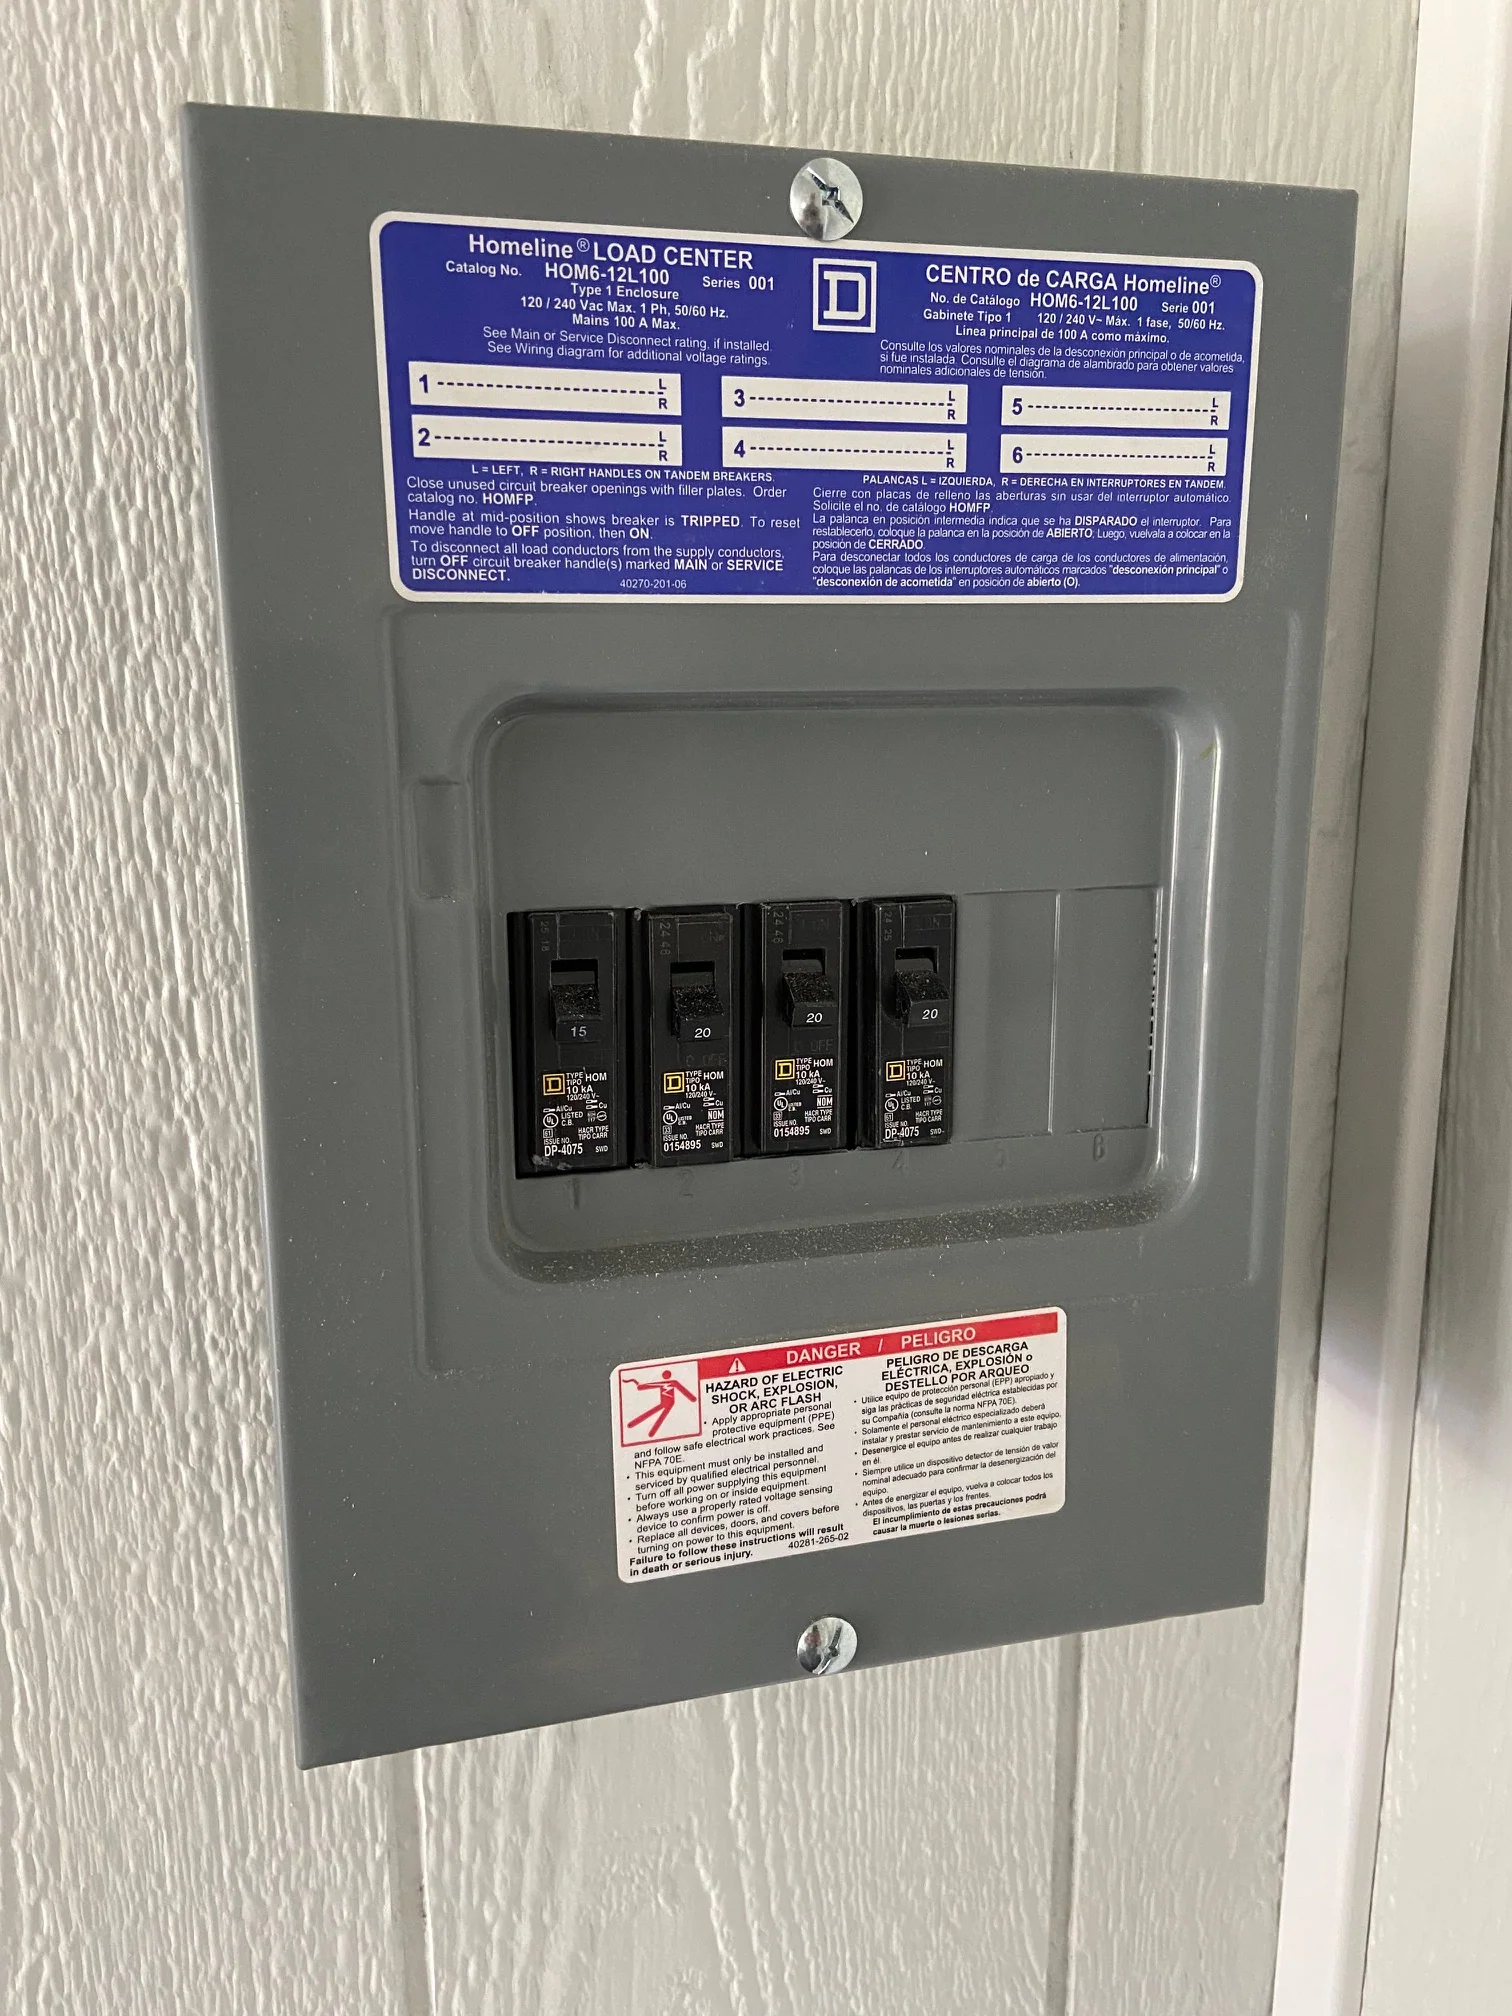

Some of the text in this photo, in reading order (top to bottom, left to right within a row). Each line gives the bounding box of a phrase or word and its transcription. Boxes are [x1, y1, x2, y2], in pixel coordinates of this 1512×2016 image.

[593, 241, 656, 264] LOAD
[663, 246, 753, 270] CENTER
[445, 260, 774, 291] Catalog No. HOM6-12L100 Series 001
[925, 263, 1012, 286] CENTRO
[1017, 268, 1040, 288] de
[1046, 269, 1118, 291] CARGA
[570, 282, 680, 300] Type 1 Enclosure
[520, 295, 543, 308] 120
[553, 297, 576, 310] 240
[579, 298, 604, 312] Vac
[607, 300, 636, 314] Max.
[640, 302, 646, 314] 1
[650, 302, 671, 317] Ph,
[674, 304, 707, 318] 50/60
[710, 306, 729, 319] Hz.
[930, 291, 1215, 315] No. de Catálogo HOM6-12L100 Serie 001
[572, 313, 680, 330] Mains 100 A Max.
[923, 308, 974, 322] Gabinete
[977, 310, 1002, 325] Tipo
[1005, 311, 1011, 323] 1
[1037, 312, 1057, 324] 120
[1065, 313, 1086, 325] 240
[1105, 314, 1131, 327] Máx.
[1137, 316, 1142, 327] 1
[1146, 316, 1172, 330] fase,
[1177, 318, 1206, 330] 50/60
[1208, 319, 1225, 331] Hz.
[955, 324, 1170, 344] Línea principal de 100 A como máximo.
[419, 374, 428, 393] 1
[659, 378, 667, 390] L
[734, 389, 745, 407] 3
[949, 390, 955, 401] L
[1212, 397, 1219, 408] L
[659, 398, 667, 410] R
[1012, 398, 1022, 415] 5
[947, 409, 956, 420] R
[1210, 415, 1218, 426] R
[418, 427, 431, 446] 2
[659, 431, 667, 442] L
[734, 440, 746, 458] 4
[948, 439, 954, 450] L
[1209, 444, 1216, 454] L
[659, 450, 668, 461] R
[1013, 446, 1023, 464] 6
[946, 457, 954, 468] R
[1208, 462, 1215, 472] R
[471, 464, 479, 474] L
[491, 464, 524, 477] LEFT,
[529, 465, 538, 476] R
[550, 466, 586, 478] RIGHT
[588, 467, 642, 479] HANDLES
[644, 469, 661, 480] ON
[663, 469, 710, 481] TANDEM
[712, 471, 776, 482] BREAKERS.
[408, 508, 800, 529] Handle at mid-position shows breaker is TRIPPED. To reset
[812, 538, 927, 551] posición de CERRADO.
[412, 567, 511, 582] DISCONNECT.
[619, 578, 687, 589] 40270-201-06
[806, 1012, 823, 1023] 20
[922, 1009, 938, 1020] 20
[570, 1026, 587, 1037] 15
[694, 1028, 711, 1038] 20
[813, 1058, 834, 1068] HOM
[923, 1059, 943, 1068] HOM
[585, 1072, 607, 1082] HOM
[703, 1071, 724, 1080] HOM
[906, 1072, 917, 1080] 10
[566, 1085, 593, 1094] 10 kA
[817, 1097, 833, 1106] NOM
[708, 1110, 724, 1120] NOM
[773, 1126, 810, 1138] 0154895
[885, 1126, 920, 1139] DP-4075
[544, 1143, 583, 1157] DP-4075
[663, 1140, 701, 1152] 0154895
[786, 1341, 861, 1365] DANGER
[901, 1326, 976, 1350] PELIGRO
[886, 1341, 1029, 1369] PELIGRO DE DESCARGA
[881, 1351, 1033, 1381] ELÉCTRICA, EXPLOSIÓN o
[705, 1365, 843, 1394] HAZARD OF ELECTRIC
[885, 1363, 1030, 1393] DESTELLO POR ARQUEO
[711, 1378, 838, 1405] SHOCK, EXPLOSION,
[729, 1391, 822, 1415] OR ARC FLASH
[711, 1400, 832, 1427] Apply appropriate personal
[861, 1417, 941, 1436] Solamente el personal
[629, 1523, 844, 1567] Failure to follow these instructions will result
[787, 1531, 850, 1549] 40281-265-02
